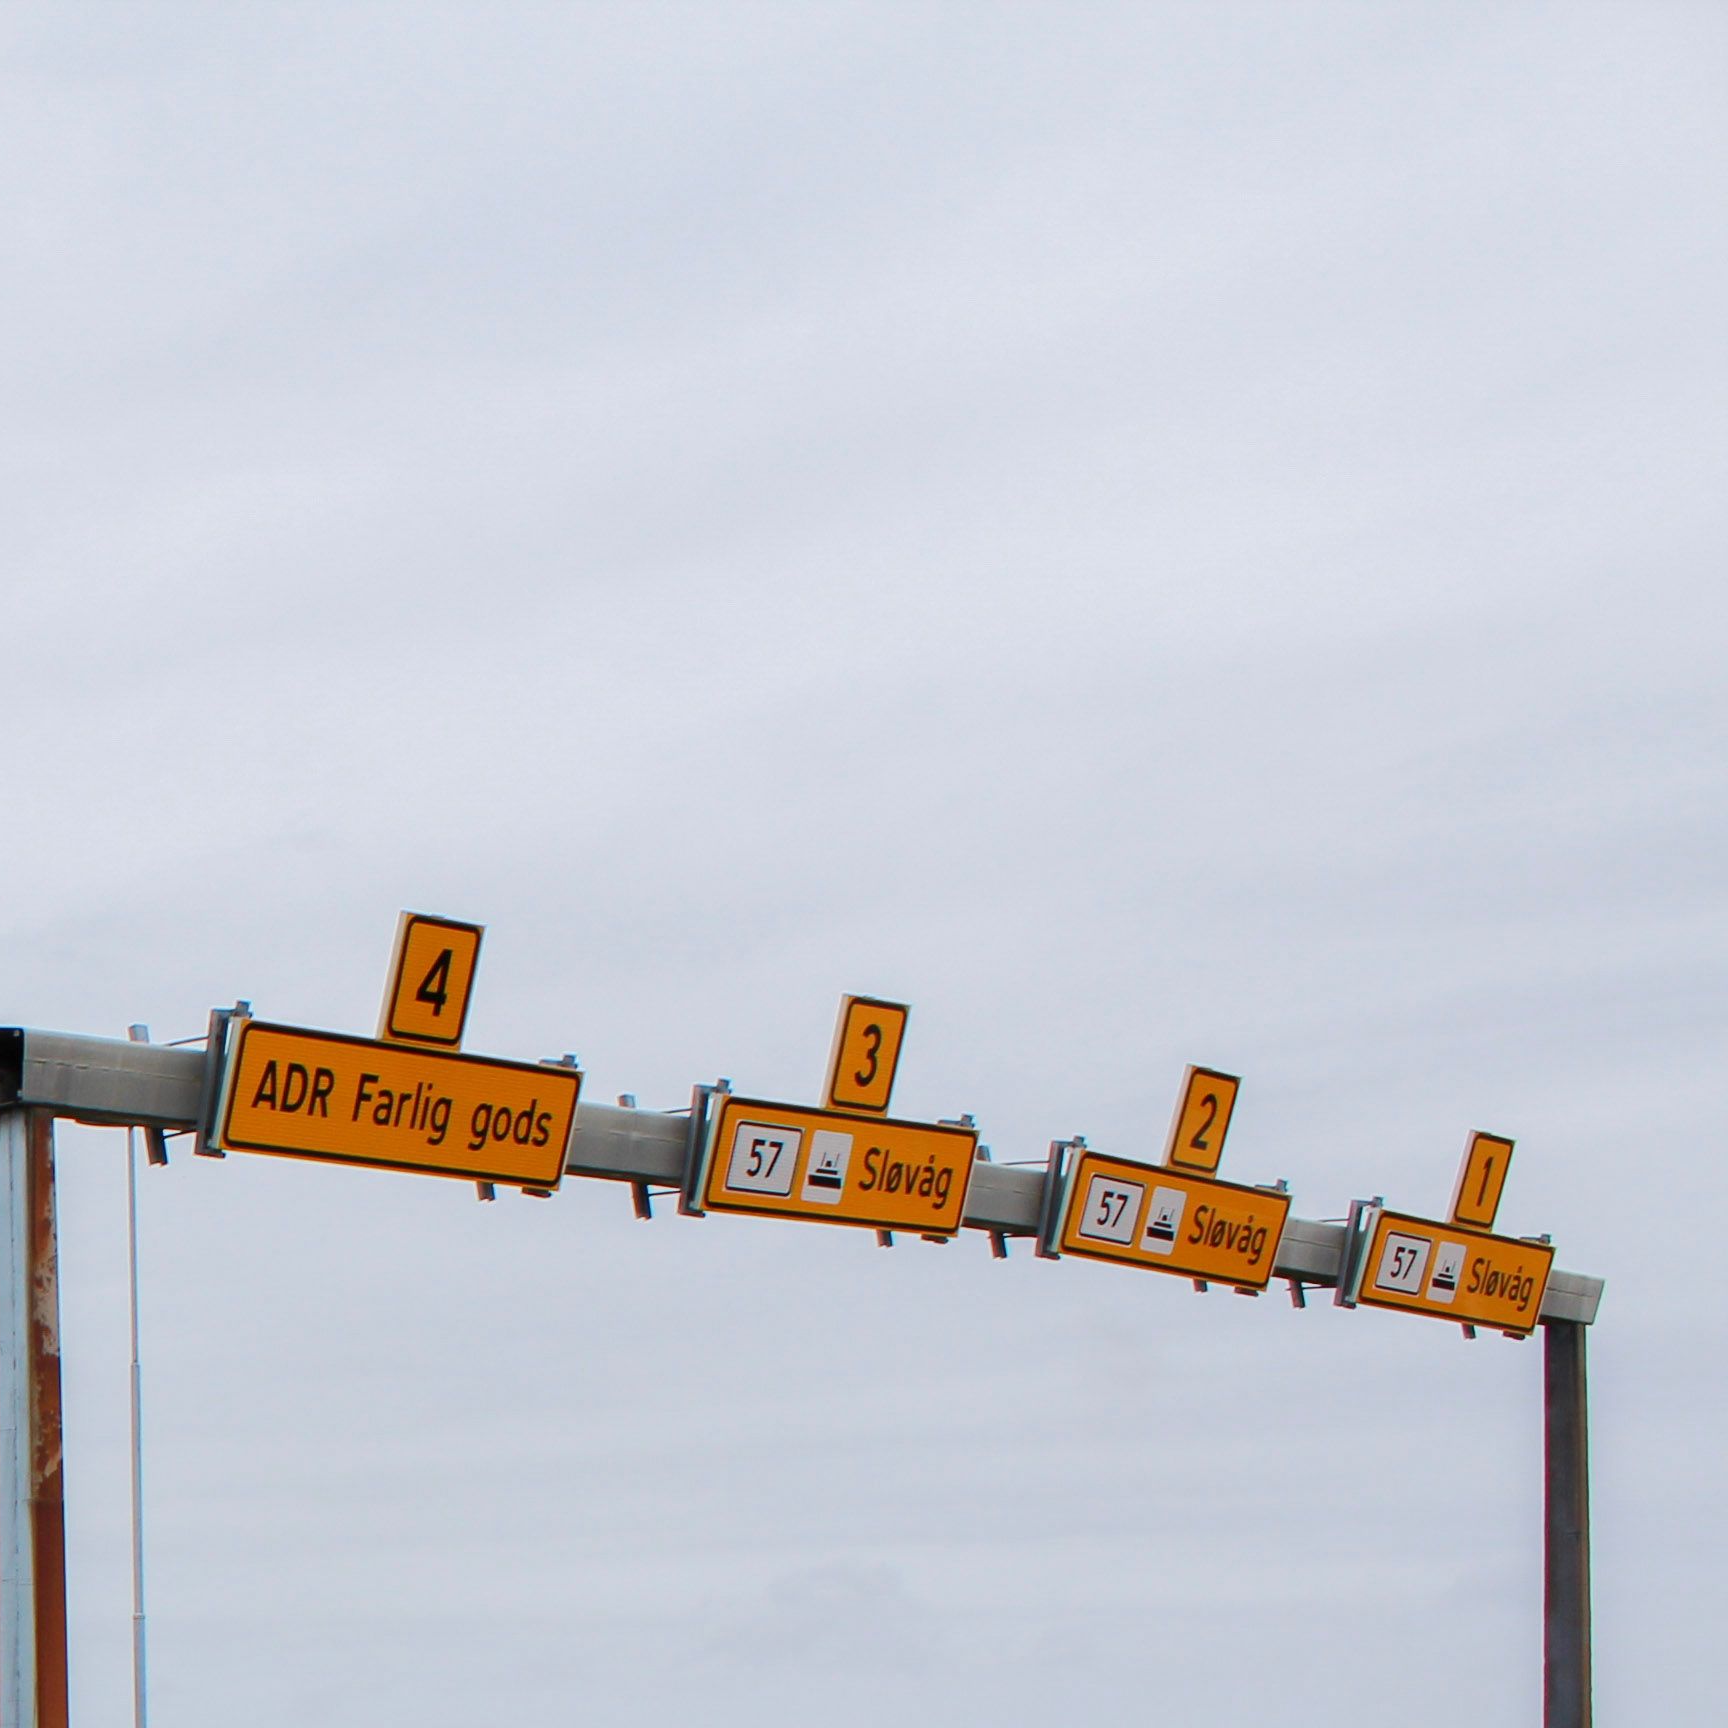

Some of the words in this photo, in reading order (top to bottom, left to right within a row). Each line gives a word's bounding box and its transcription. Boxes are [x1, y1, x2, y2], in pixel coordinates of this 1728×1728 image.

[415, 948, 454, 1017] 4
[853, 1023, 882, 1088] 3
[251, 1059, 336, 1119] ADR
[351, 1072, 454, 1146] Farlig
[467, 1099, 554, 1152] gods
[1189, 1092, 1219, 1151] 2
[745, 1138, 784, 1179] 57
[857, 1146, 954, 1210] Sløvåg
[1476, 1155, 1494, 1207] 1
[1096, 1190, 1130, 1228] 57
[1187, 1204, 1269, 1266] Sløvåg
[1390, 1245, 1418, 1280] 57
[1466, 1257, 1535, 1312] Sløvåg
